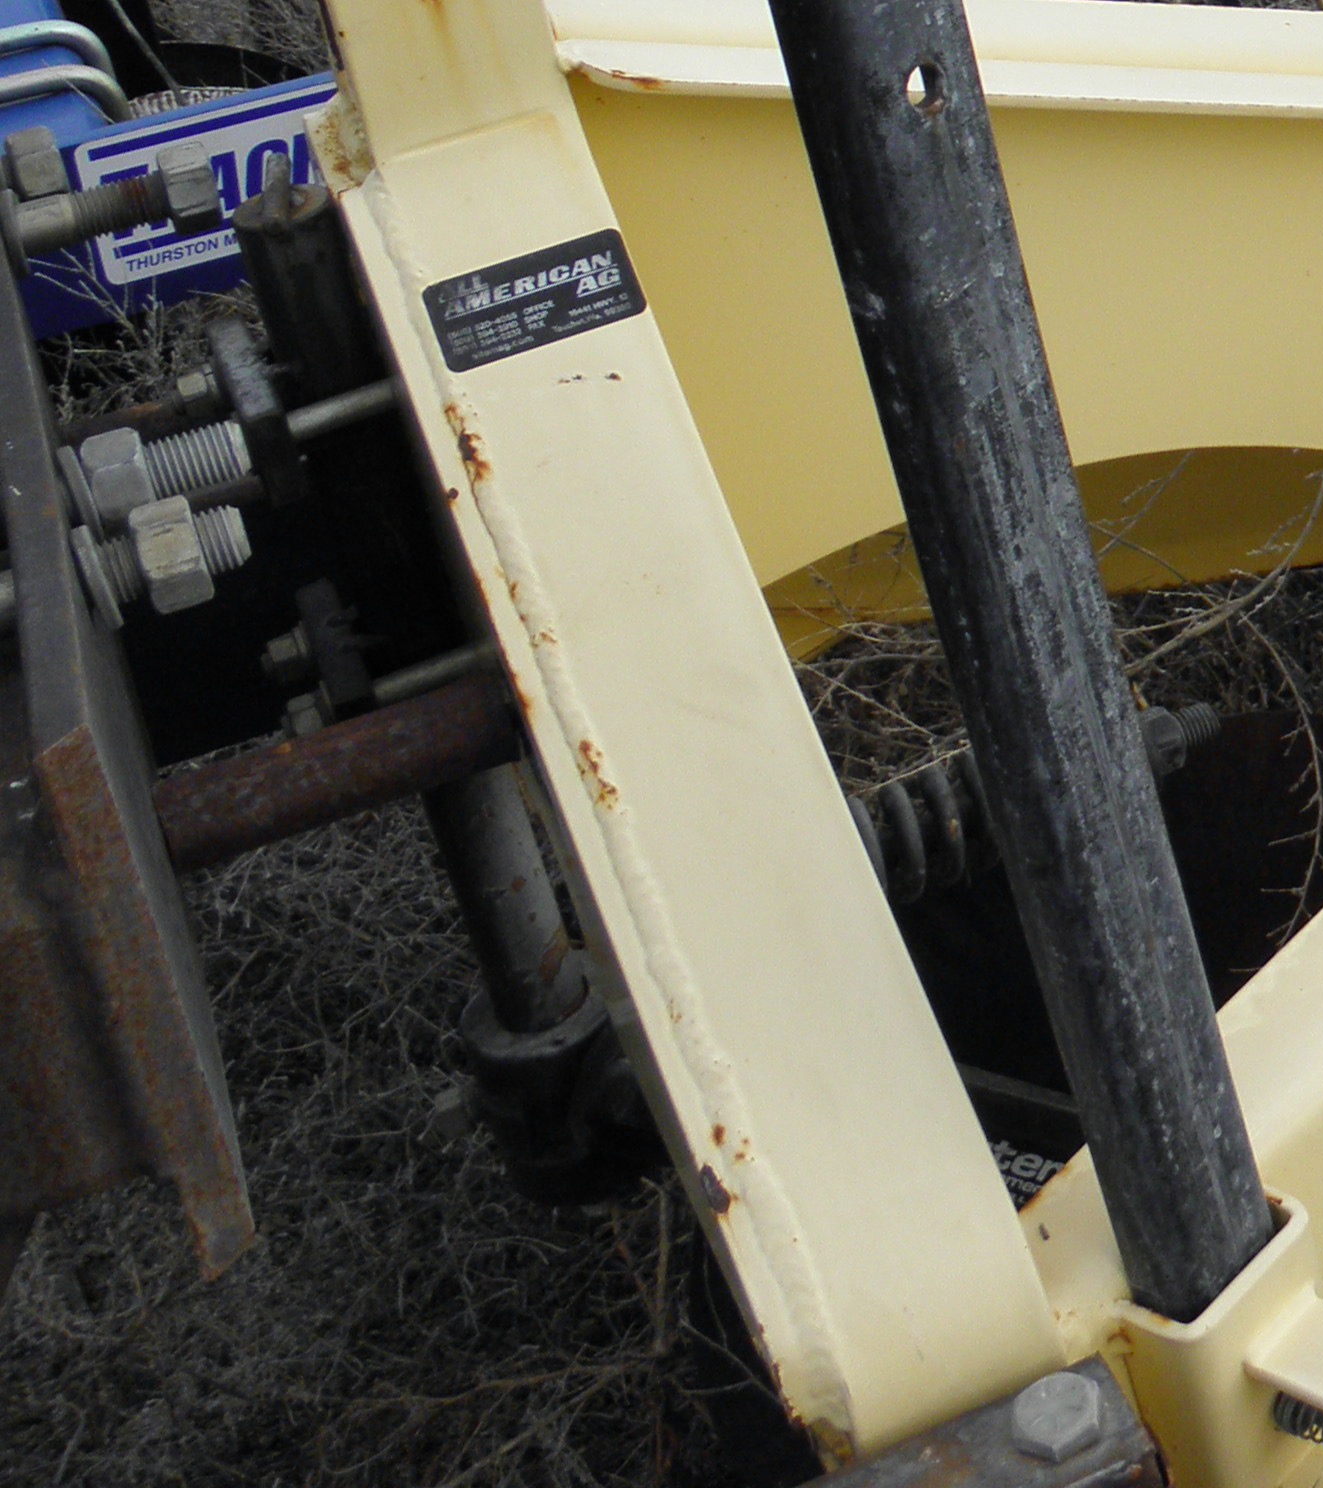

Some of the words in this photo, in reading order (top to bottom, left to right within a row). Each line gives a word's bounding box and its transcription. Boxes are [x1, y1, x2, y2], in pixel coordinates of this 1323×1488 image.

[125, 237, 219, 272] THURSTON
[444, 250, 613, 317] AMERICAN
[576, 267, 621, 297] AG
